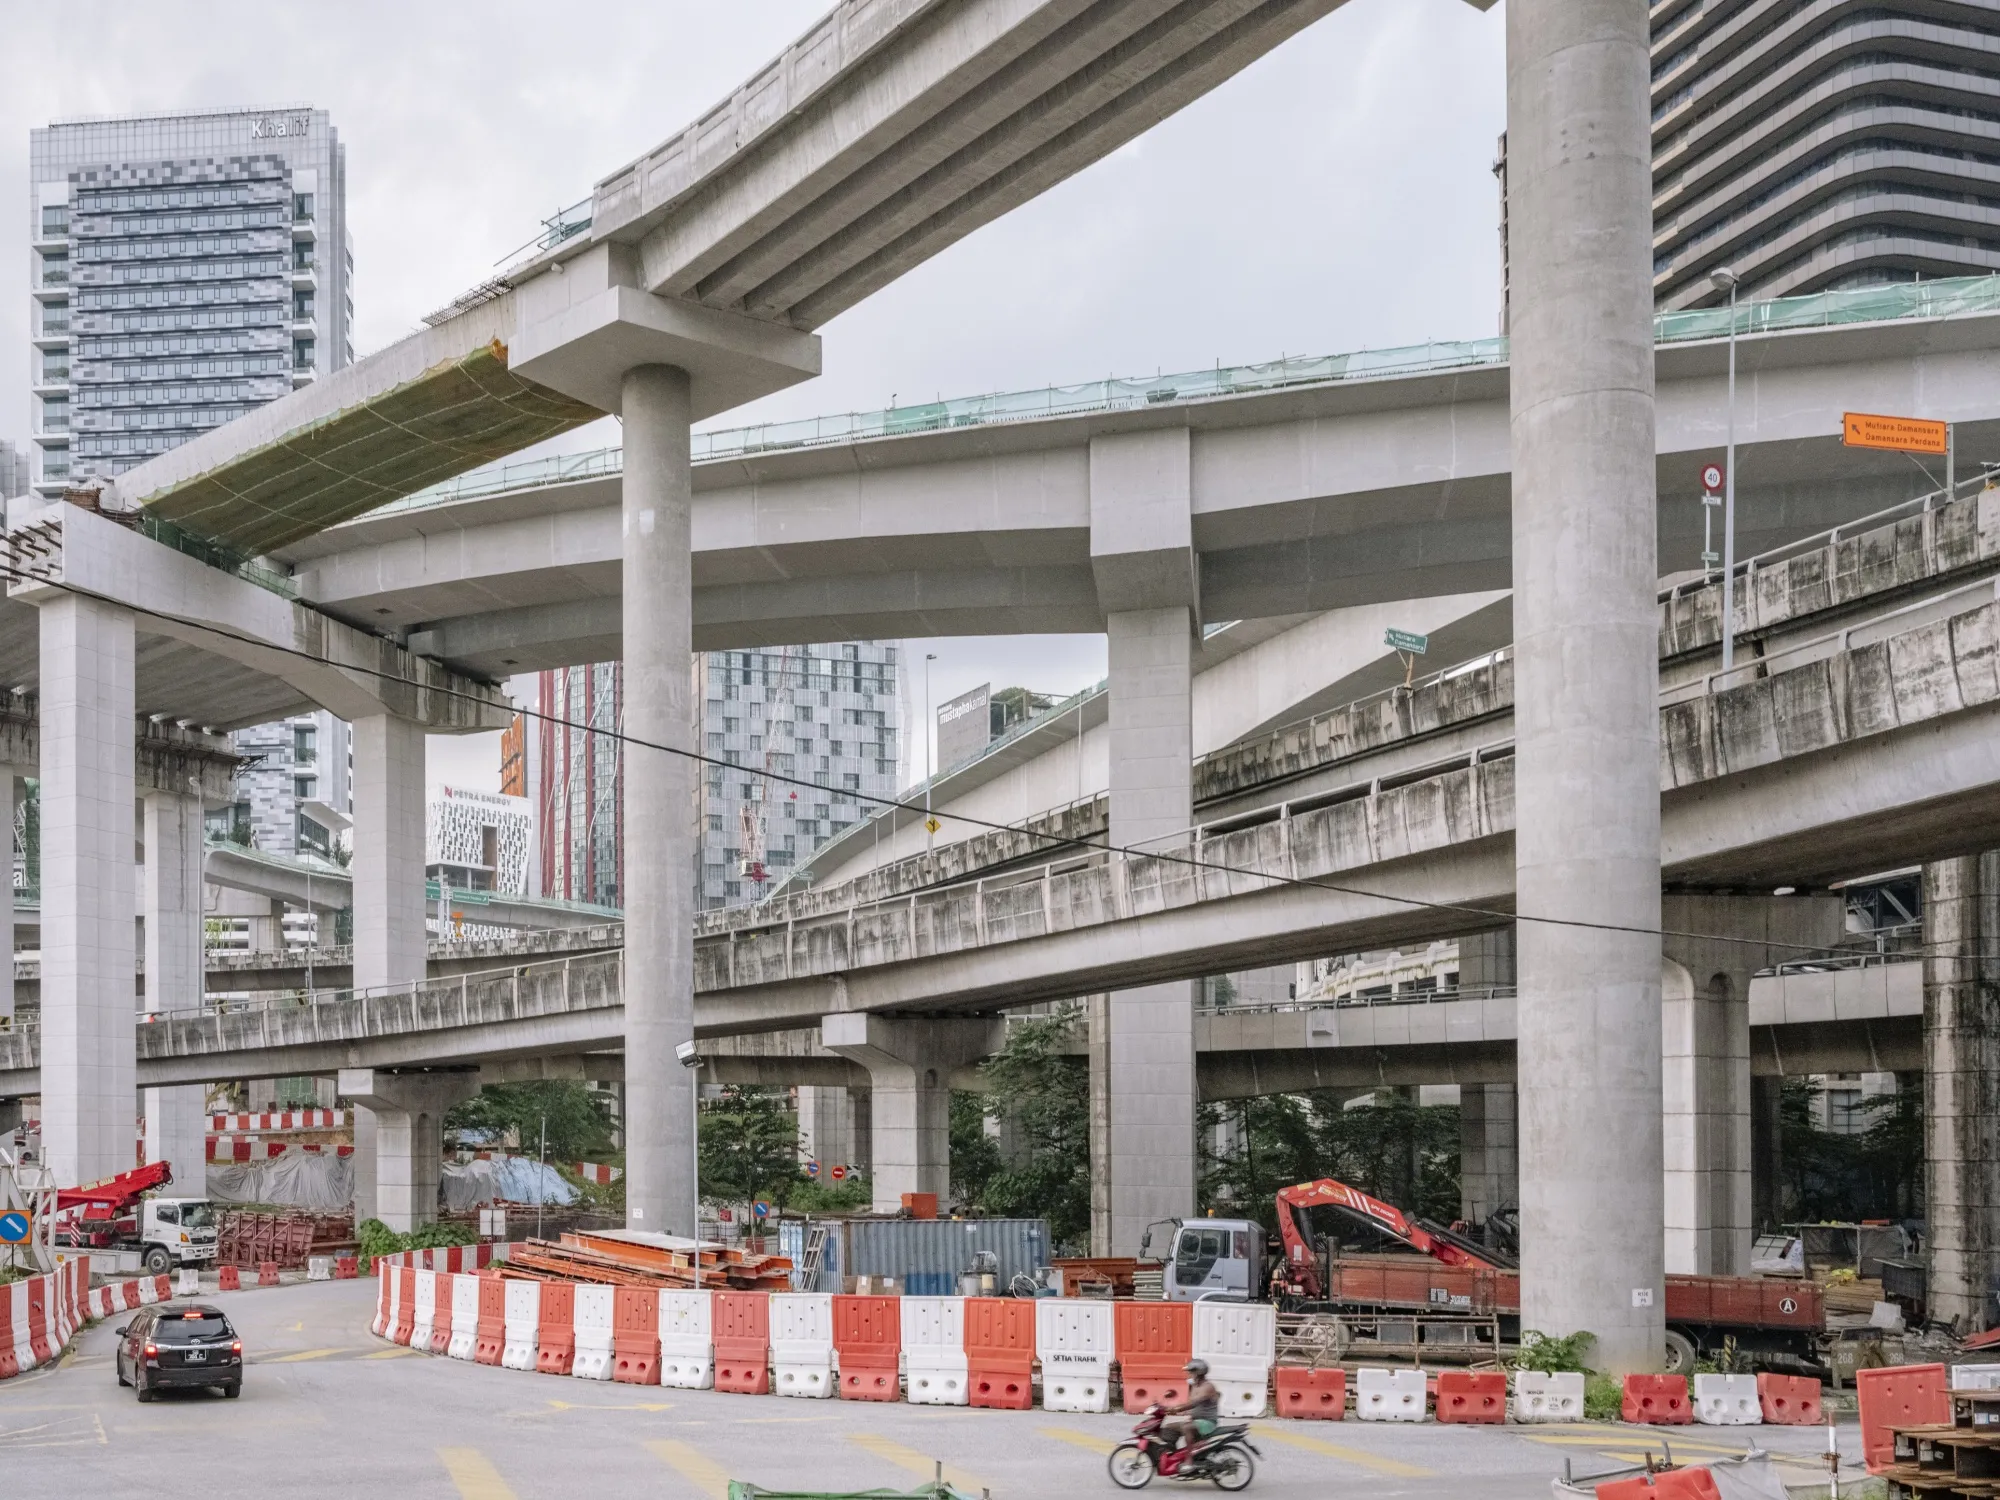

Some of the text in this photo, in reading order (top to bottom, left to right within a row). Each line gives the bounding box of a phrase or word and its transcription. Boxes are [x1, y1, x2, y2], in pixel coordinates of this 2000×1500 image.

[251, 116, 310, 139] Khalif
[1865, 421, 1939, 435] Mutiara Damansara
[1865, 433, 1941, 447] Damansara Perdana
[1707, 473, 1718, 483] 40
[454, 790, 511, 806] PETRA ENERGY
[1053, 1354, 1098, 1363] SETIA TRAFIK
[1837, 1352, 1854, 1364] 268
